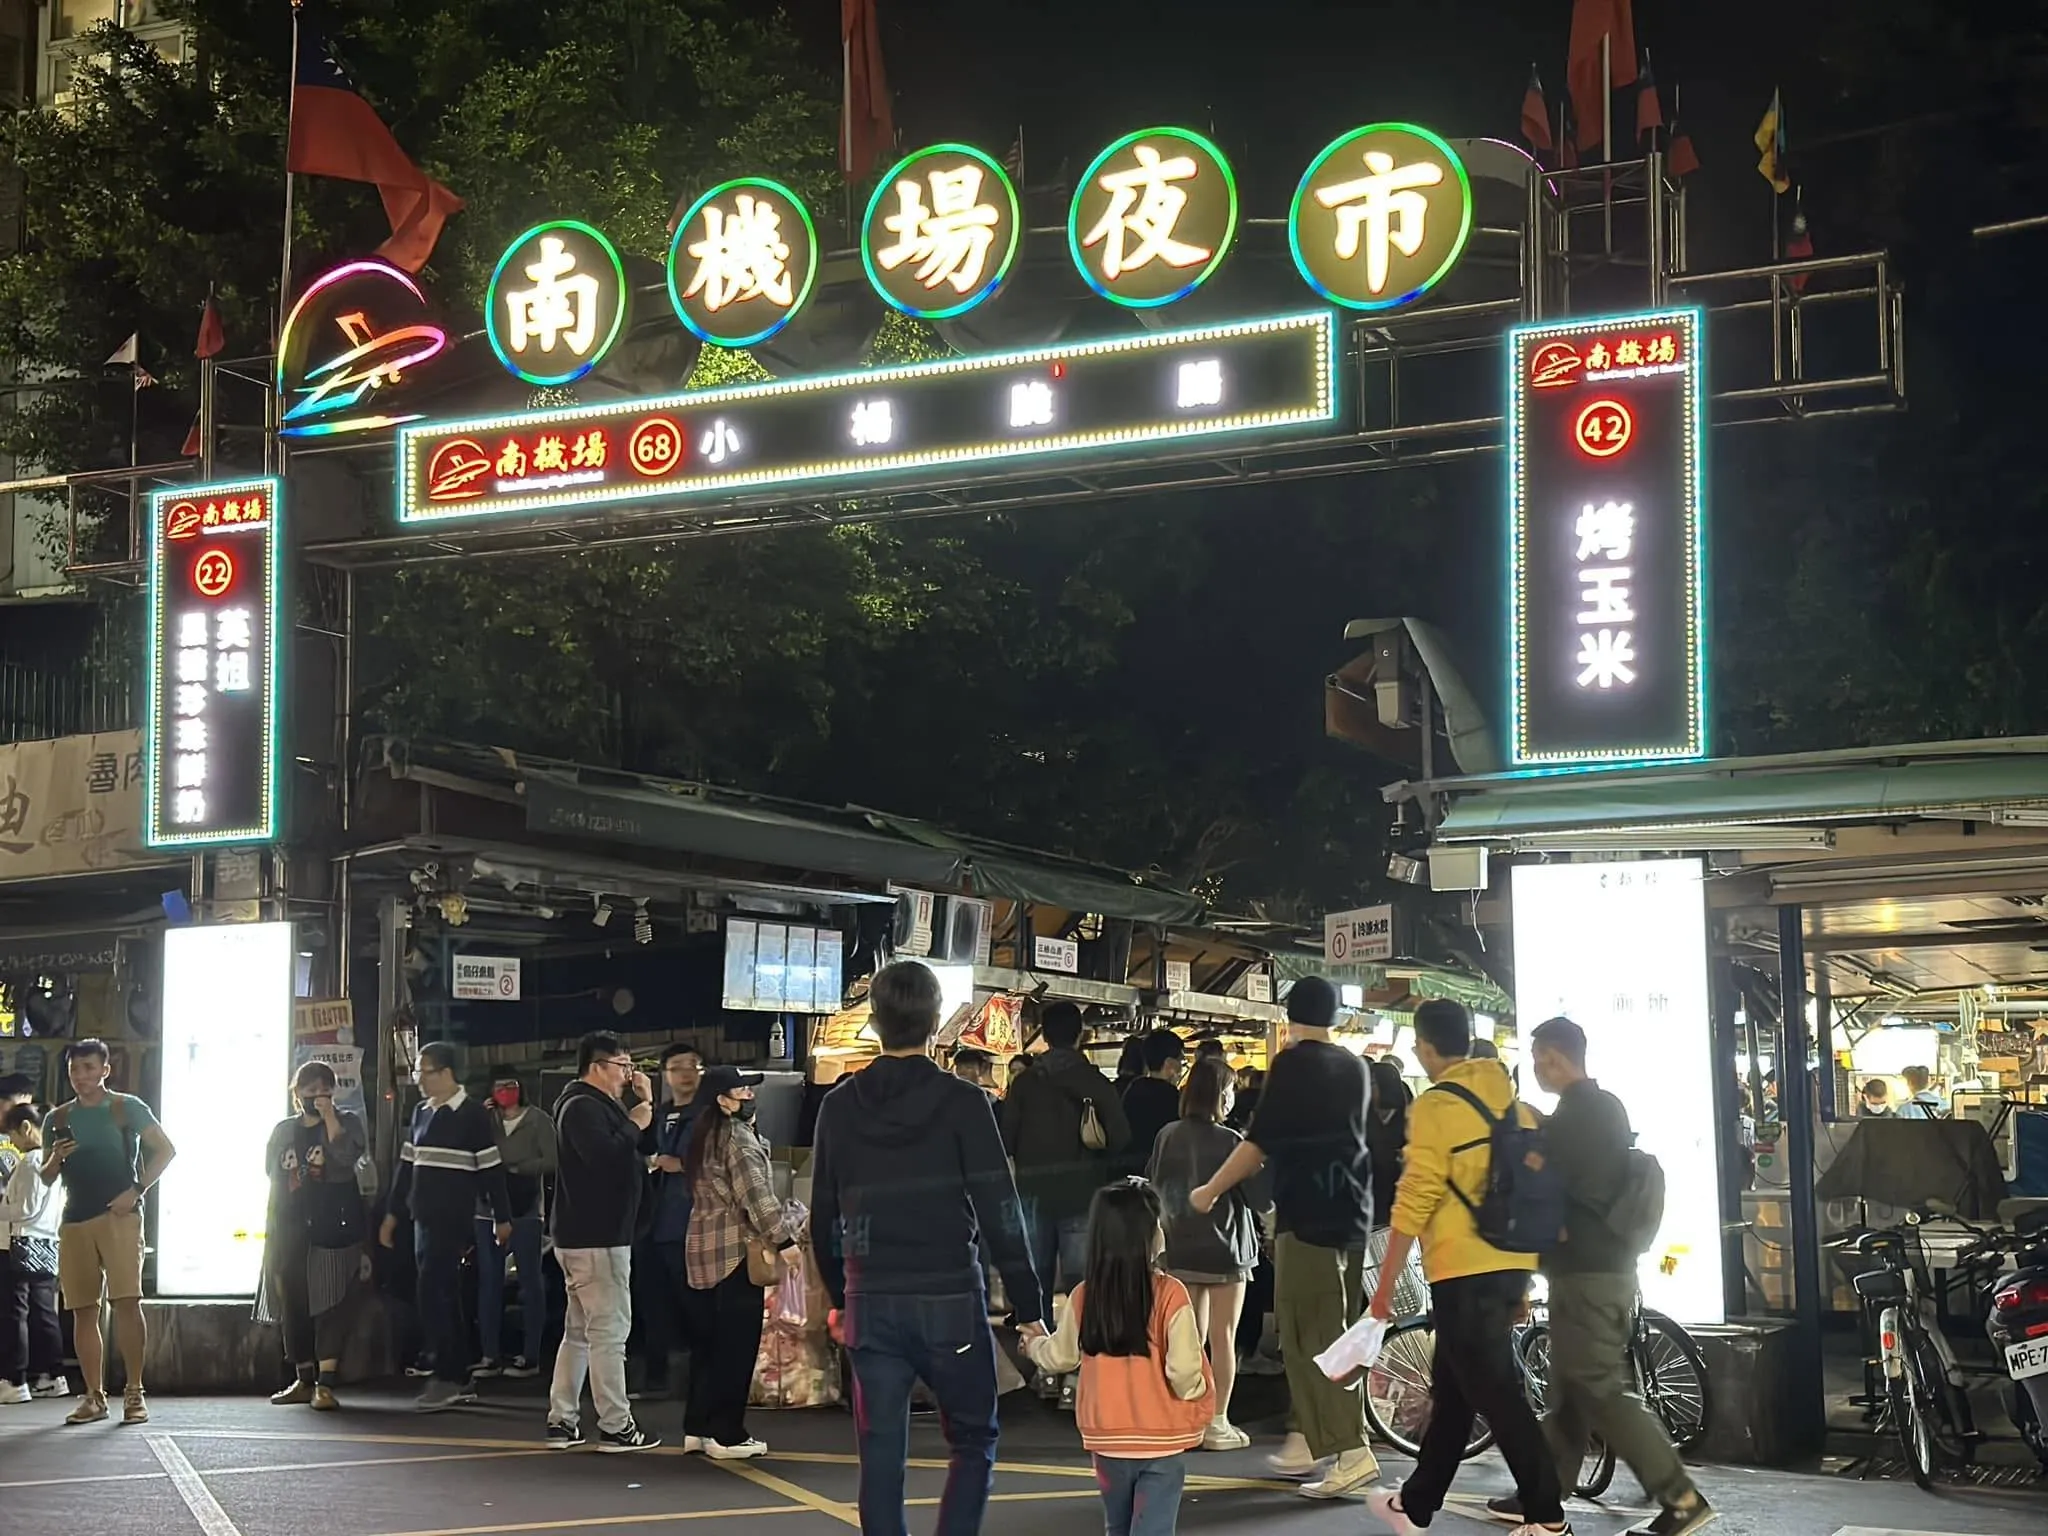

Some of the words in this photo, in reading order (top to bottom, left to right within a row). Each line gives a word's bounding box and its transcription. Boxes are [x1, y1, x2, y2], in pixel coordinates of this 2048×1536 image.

[505, 145, 1444, 356] 南機場夜市
[1585, 335, 1677, 370] 南機場
[1584, 415, 1625, 442] 42
[496, 430, 607, 478] 南機場
[637, 433, 671, 464] 68
[202, 497, 262, 525] 南機場
[200, 562, 228, 585] 22
[1575, 501, 1635, 689] 烤玉米
